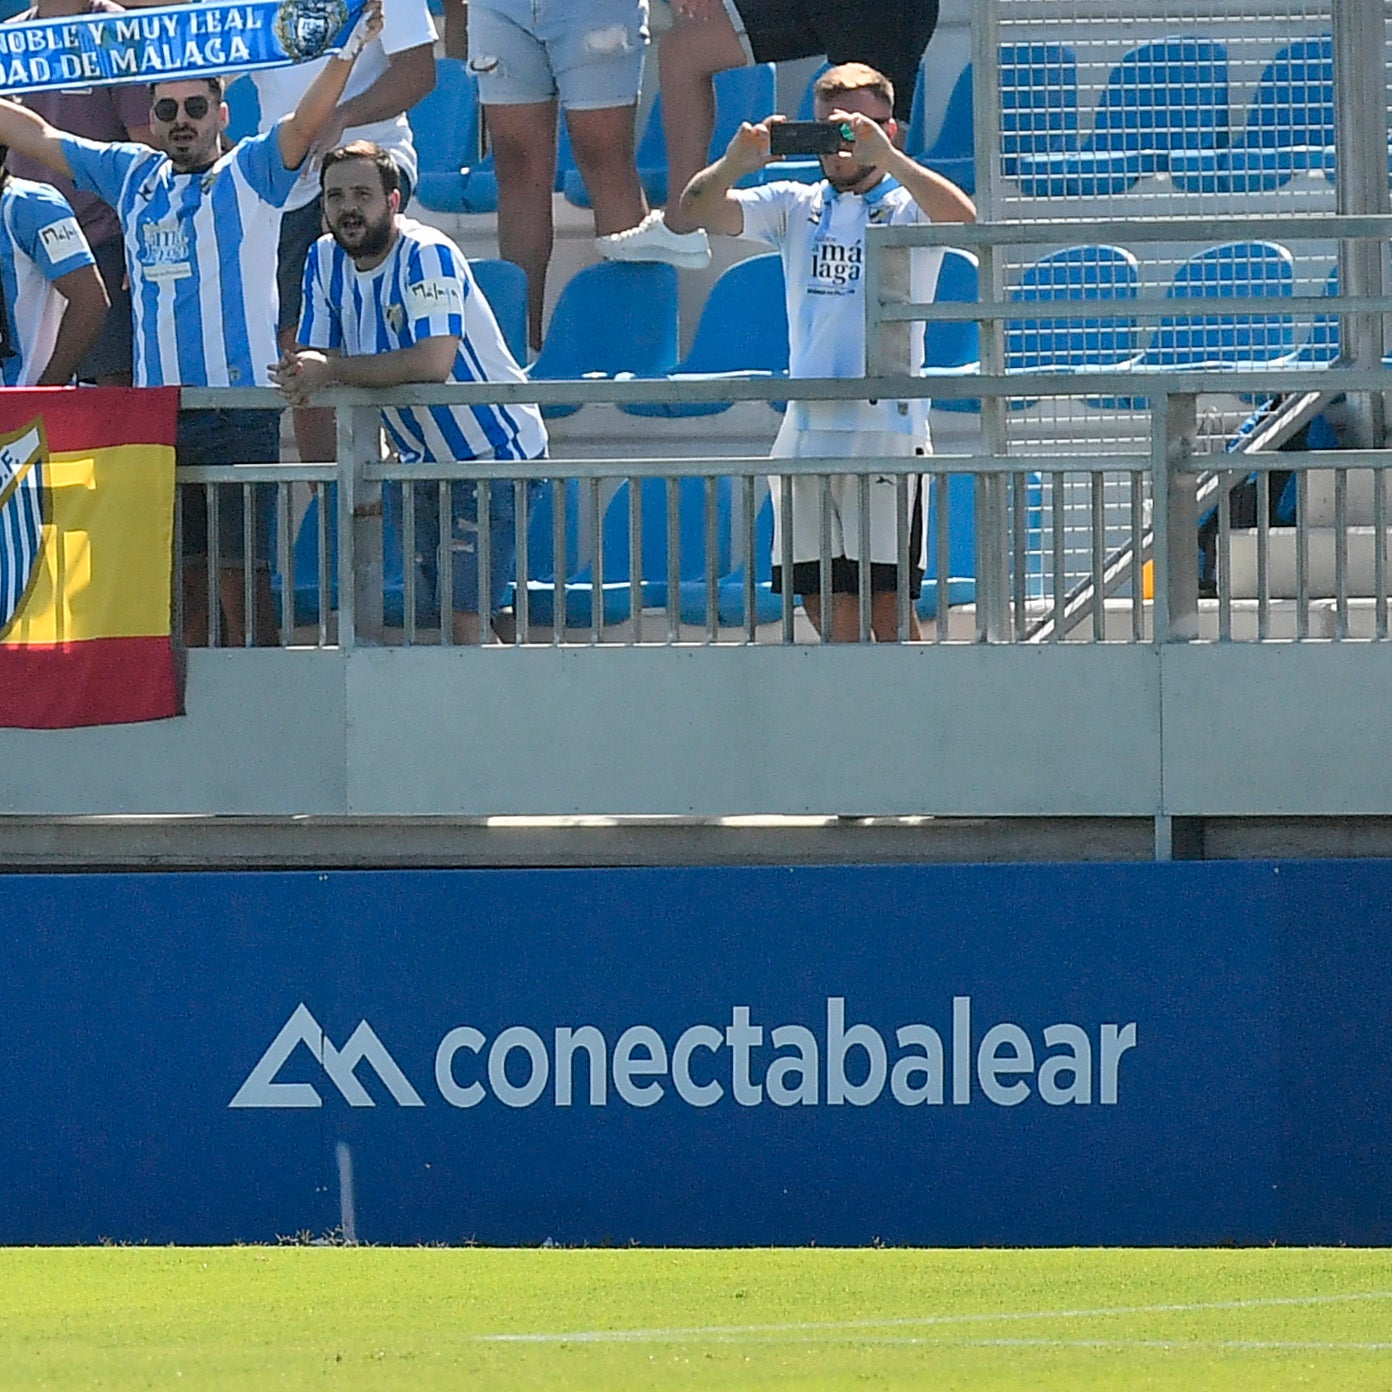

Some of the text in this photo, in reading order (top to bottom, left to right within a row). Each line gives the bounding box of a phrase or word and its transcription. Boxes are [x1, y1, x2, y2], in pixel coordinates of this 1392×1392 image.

[89, 20, 108, 45] Y
[116, 15, 179, 42] MUY
[189, 6, 262, 34] LEAL
[56, 52, 101, 79] DE
[813, 255, 861, 285] laga
[435, 996, 1137, 1108] conectabalear
